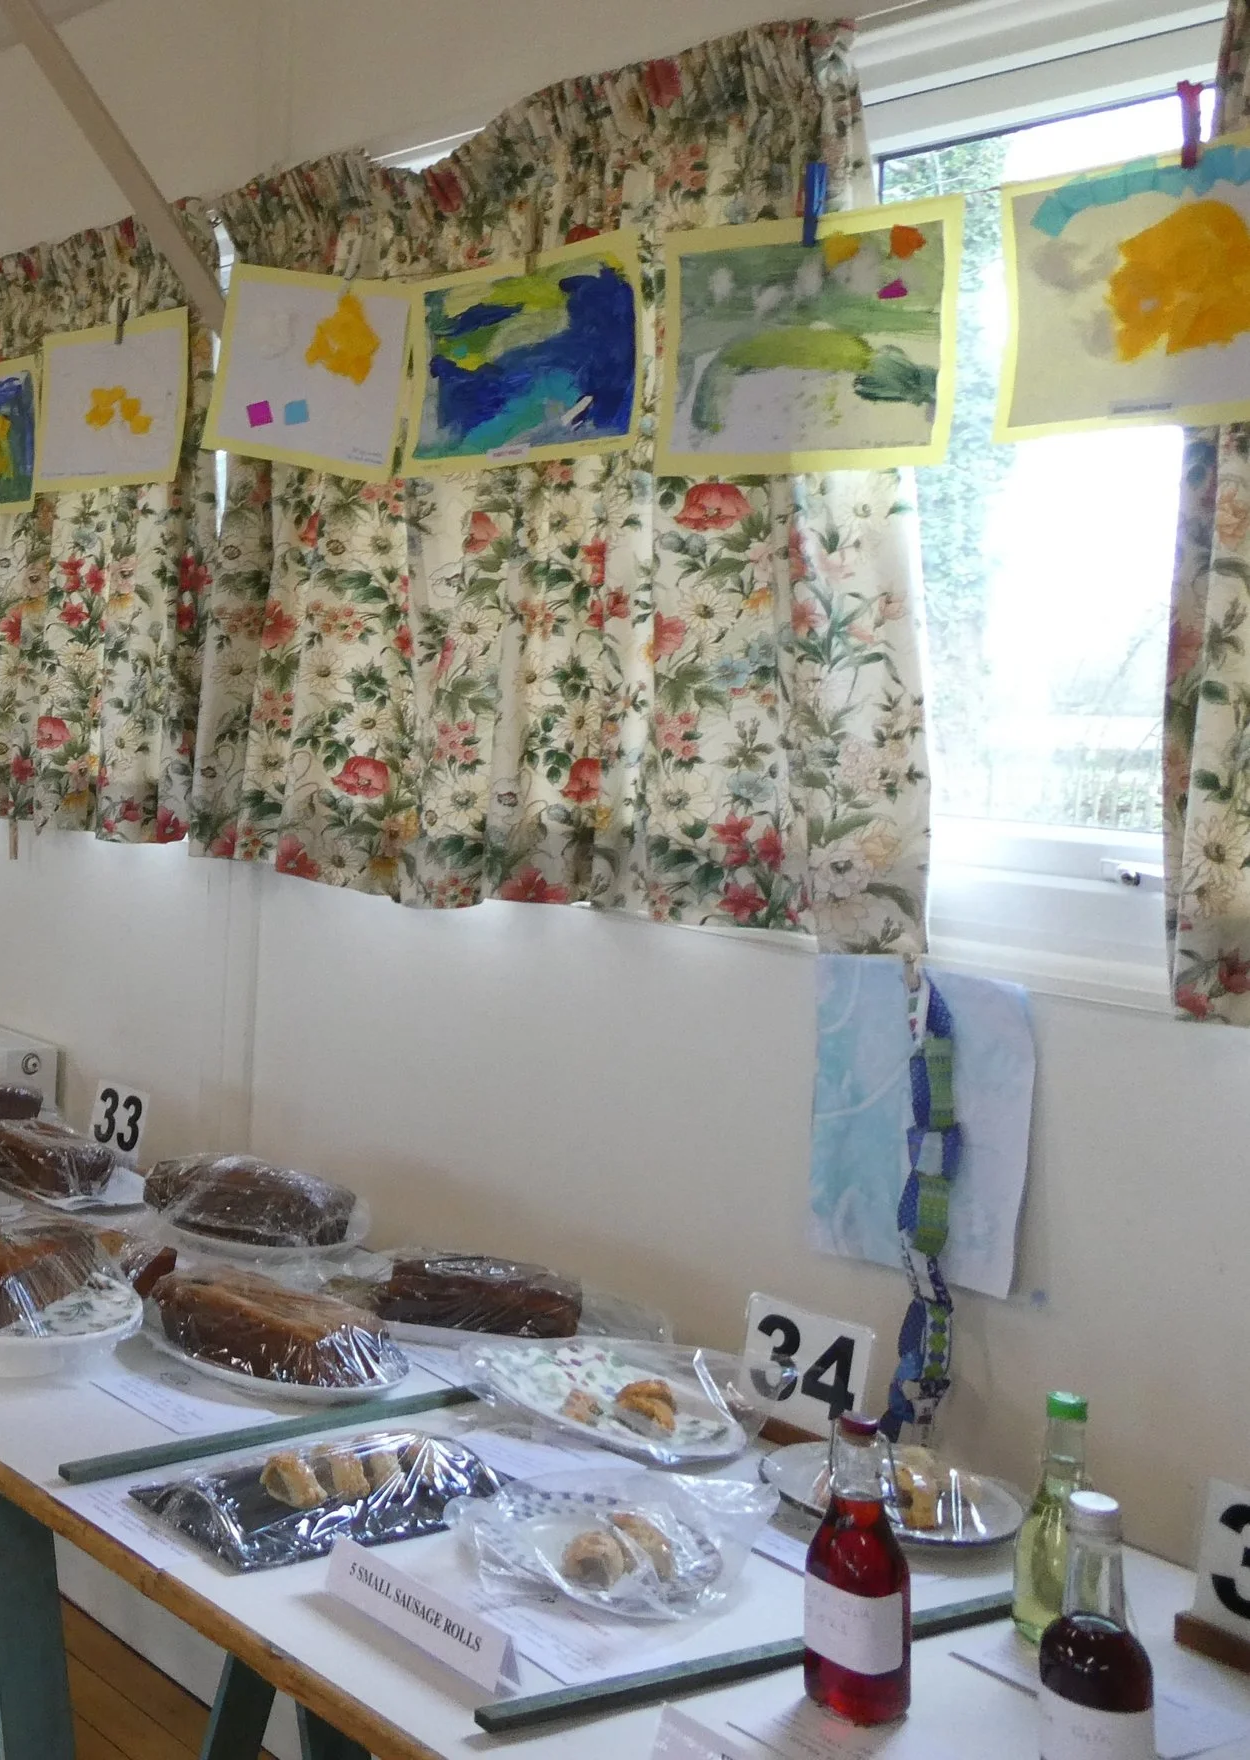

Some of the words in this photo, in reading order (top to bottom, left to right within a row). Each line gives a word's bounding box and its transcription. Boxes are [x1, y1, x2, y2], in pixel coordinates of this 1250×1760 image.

[94, 1088, 142, 1151] 33
[750, 1314, 855, 1420] 34
[349, 1562, 358, 1576] 5
[356, 1567, 392, 1599] SMALL
[392, 1587, 442, 1629] SAUSAGE
[443, 1617, 482, 1653] ROLLS
